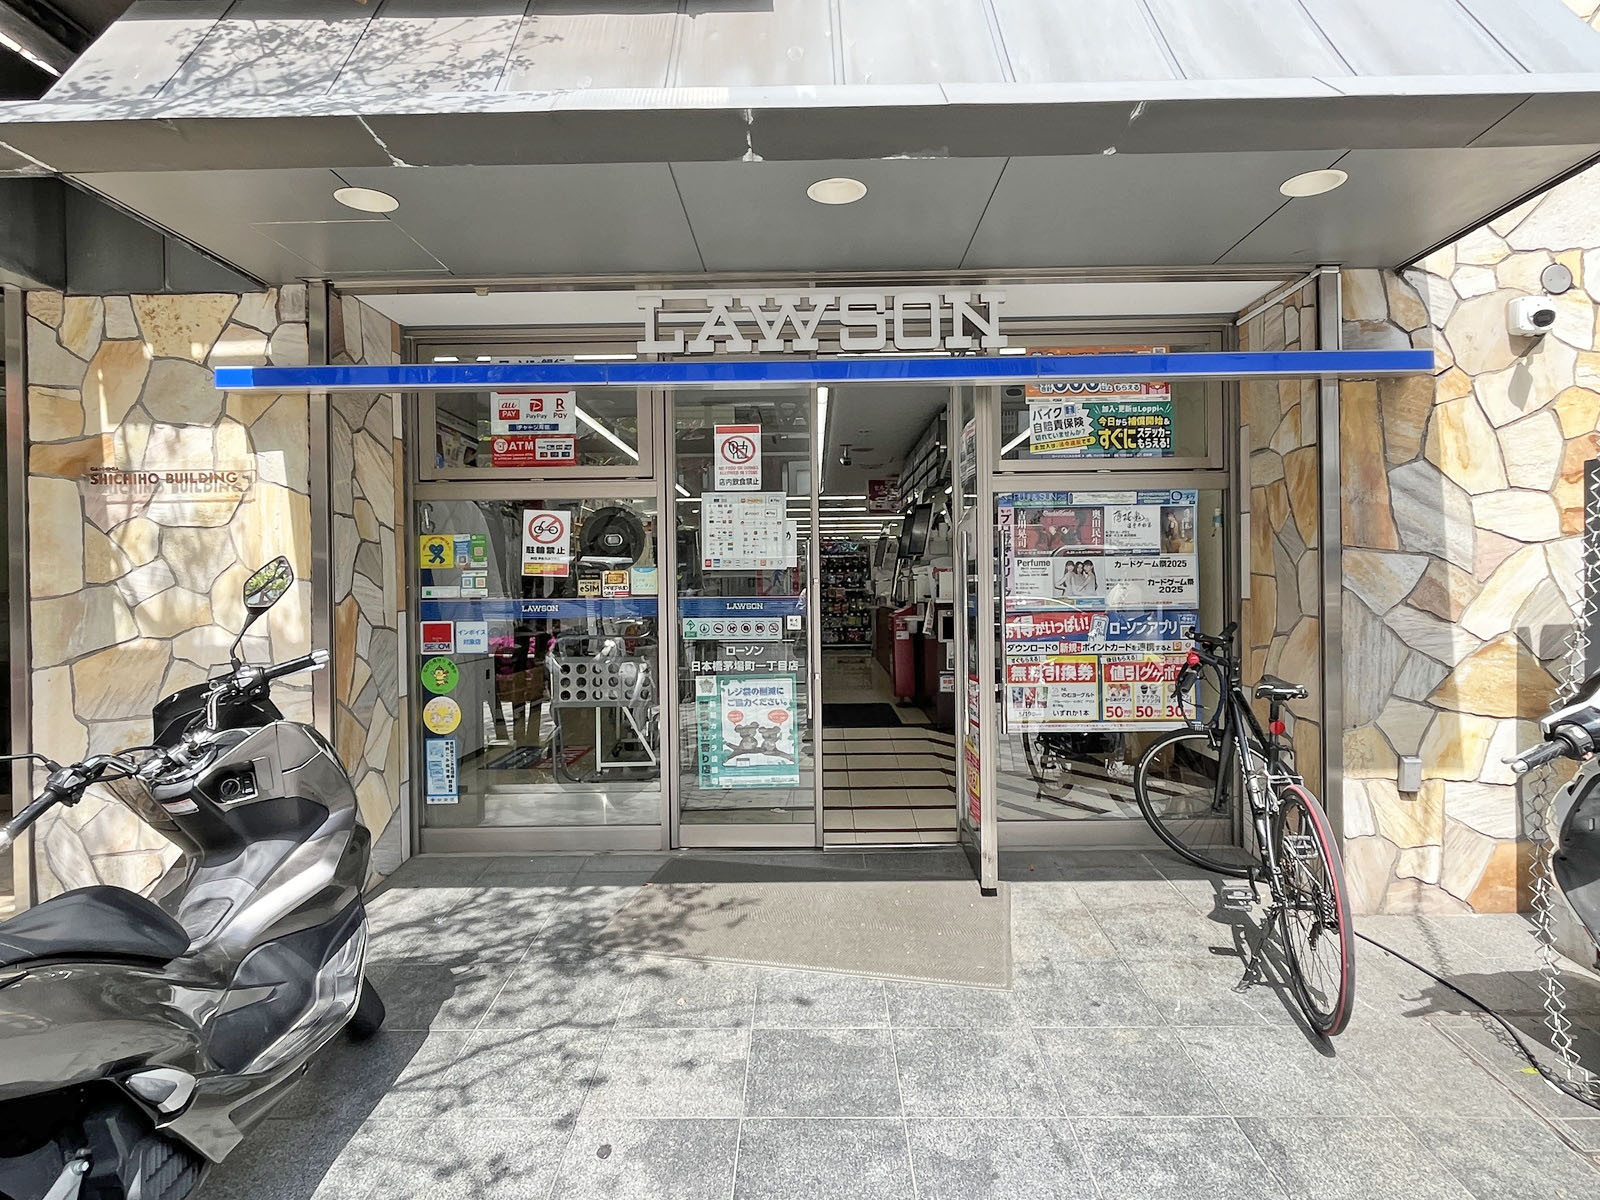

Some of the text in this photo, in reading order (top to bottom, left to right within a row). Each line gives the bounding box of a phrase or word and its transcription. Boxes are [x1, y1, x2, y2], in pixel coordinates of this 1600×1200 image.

[636, 291, 1008, 353] LAWSON
[501, 410, 517, 418] PAY
[552, 412, 568, 420] Pay
[1032, 407, 1062, 421] バイク
[1033, 416, 1085, 434] 自賠責保険
[1137, 427, 1171, 438] ステッカー
[1098, 428, 1137, 450] すぐに
[1137, 439, 1171, 449] もらえる!
[508, 441, 534, 451] ATM
[90, 471, 238, 485] SHICHIHO BUILDING
[719, 477, 760, 486] 店内飲食禁止
[1091, 508, 1102, 546] 奥田民生
[525, 545, 566, 555] 駐輪禁止
[1016, 559, 1051, 568] Perfume
[1113, 559, 1188, 569] カードゲーム祭2025
[1147, 578, 1195, 587] カードゲーム祭
[579, 584, 600, 592] eSIM
[1158, 586, 1184, 594] 2025
[522, 604, 559, 612] LAWSON
[726, 602, 764, 610] LAWSON
[1109, 619, 1178, 635] ローソンアプリ
[726, 646, 765, 656] ローソン
[691, 660, 799, 672] 日本橋茅場町一丁目店
[1010, 664, 1094, 682] 無料引換券
[1109, 664, 1182, 682] 値引クポ
[727, 686, 785, 697] レジ袋の削減に
[727, 698, 788, 707] ご協力ください。
[1106, 706, 1124, 718] 50
[1135, 706, 1154, 717] 50
[1166, 706, 1184, 717] 30
